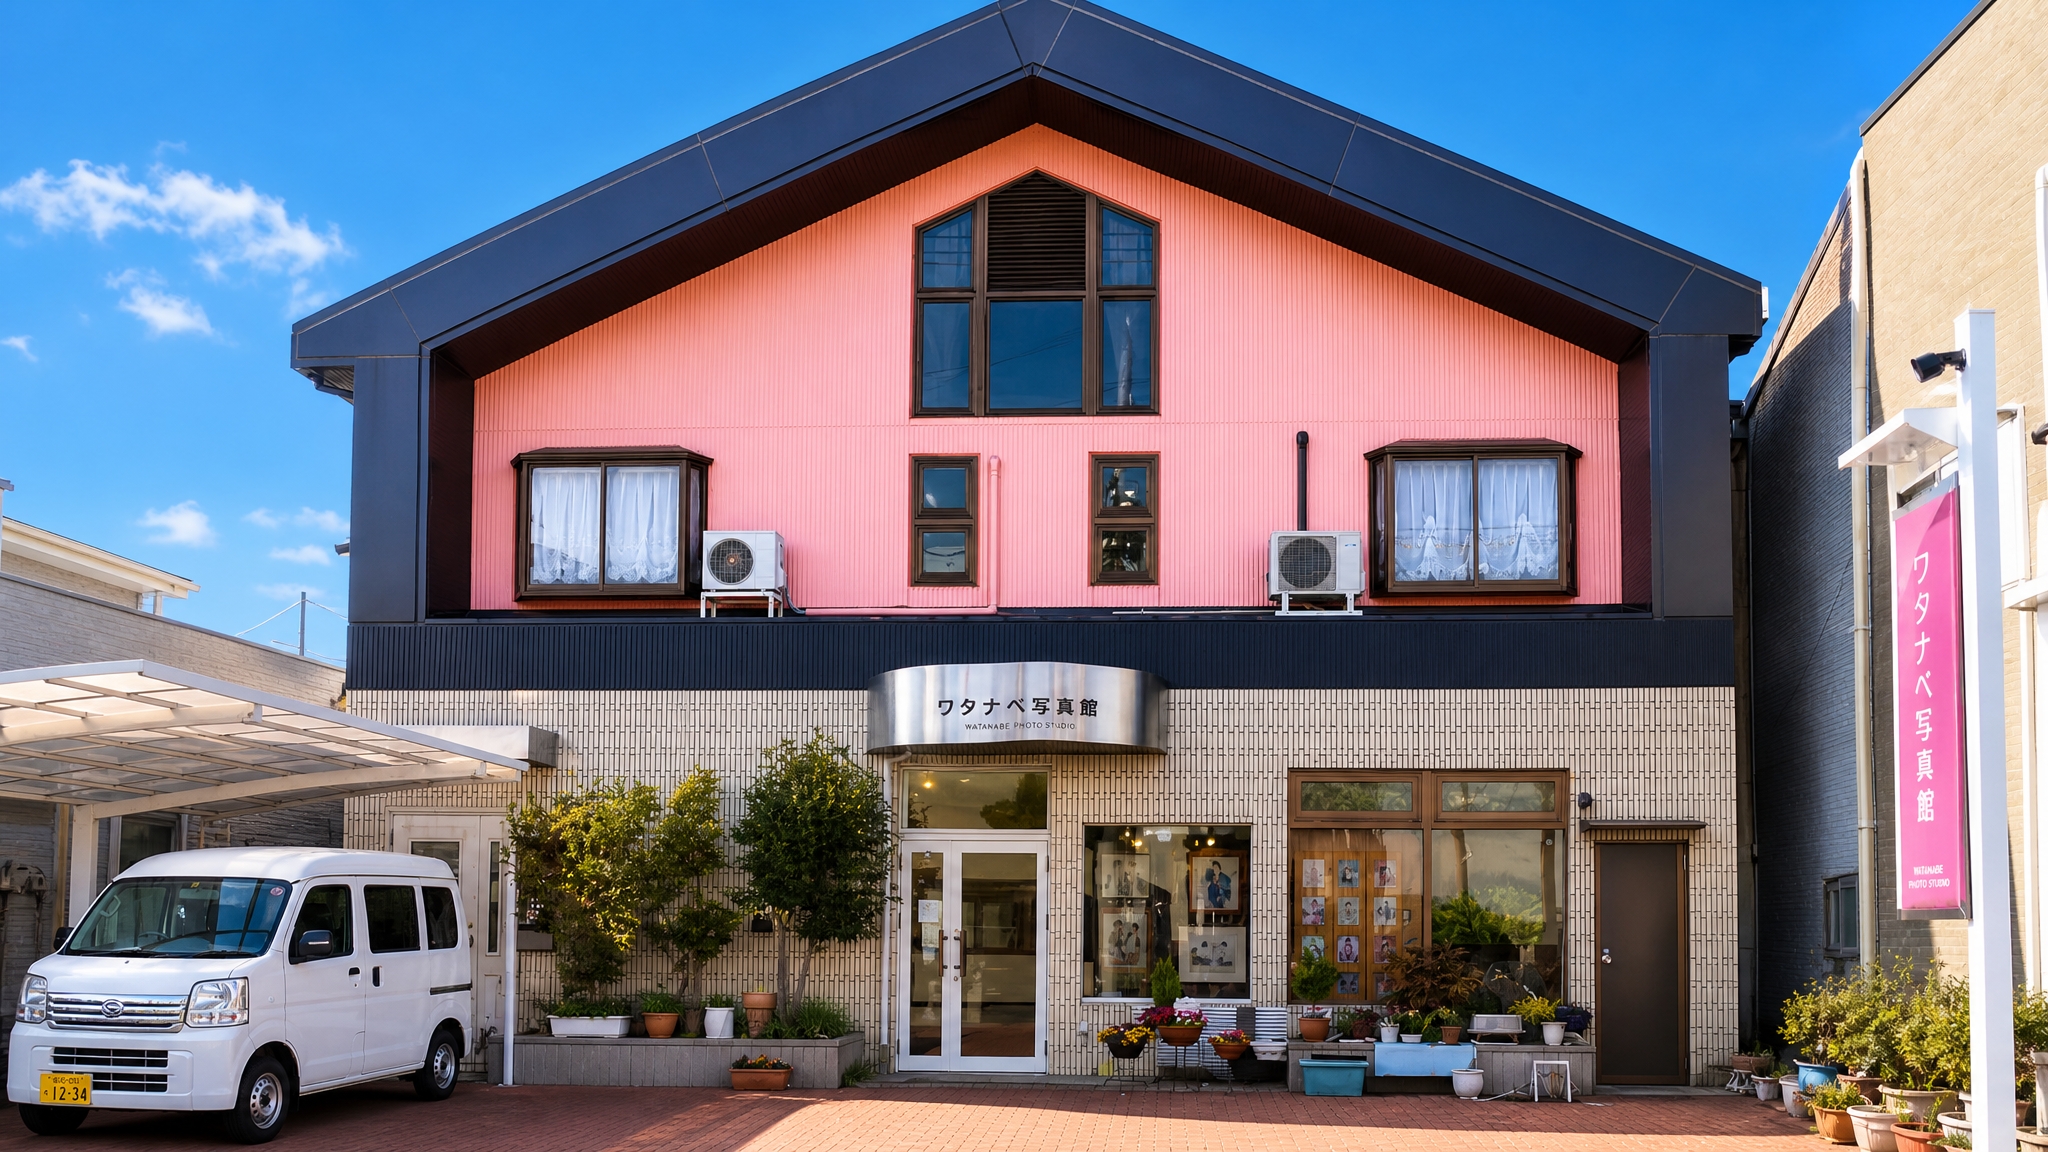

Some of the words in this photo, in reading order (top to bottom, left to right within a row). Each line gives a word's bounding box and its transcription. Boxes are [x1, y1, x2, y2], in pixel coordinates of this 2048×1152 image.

[1913, 551, 1935, 823] ワタナベ写真館
[938, 698, 1098, 717] ワタナベ写真館
[964, 722, 1010, 730] WATANABE
[1014, 721, 1043, 729] PHOTO
[1045, 721, 1076, 730] STUDIO
